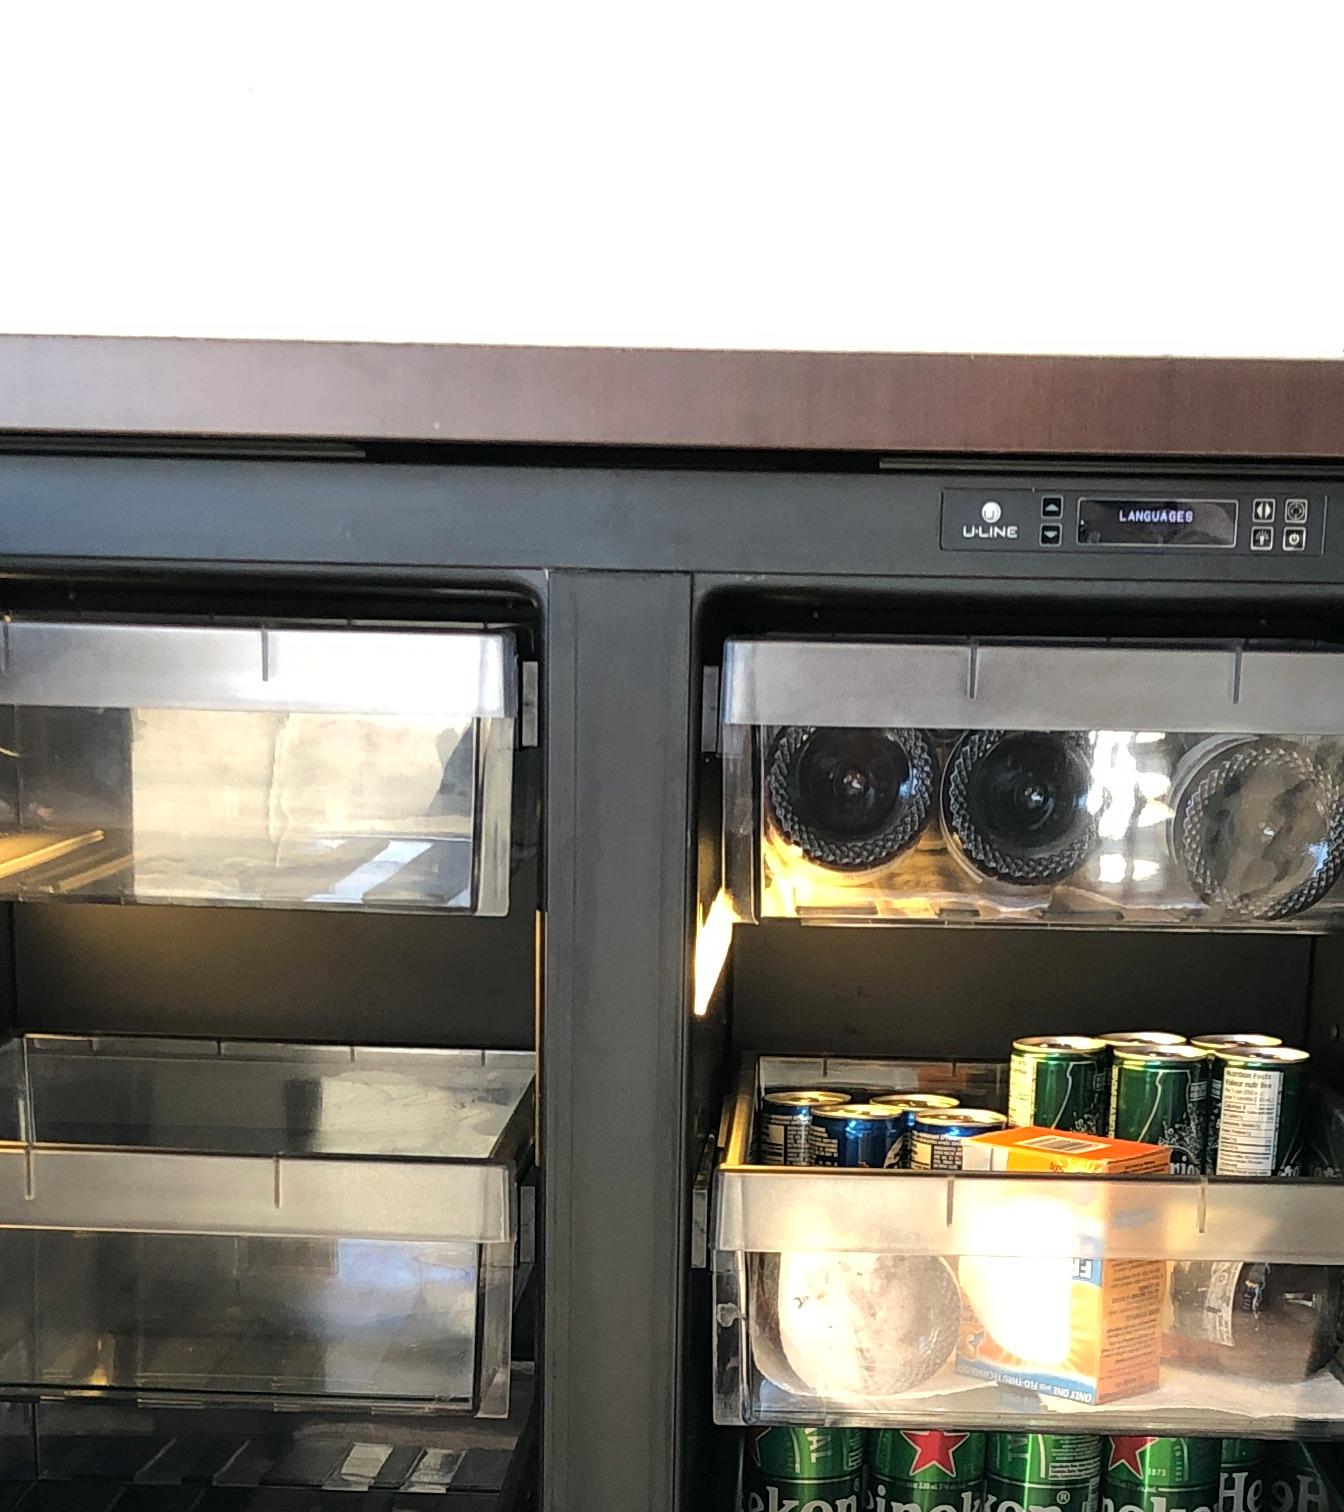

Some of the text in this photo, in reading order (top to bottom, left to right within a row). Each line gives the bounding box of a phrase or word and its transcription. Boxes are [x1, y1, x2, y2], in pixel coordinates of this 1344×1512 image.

[1119, 509, 1194, 524] LANGUAGES
[1052, 1386, 1069, 1399] ONE
[1068, 1390, 1093, 1403] ONLY
